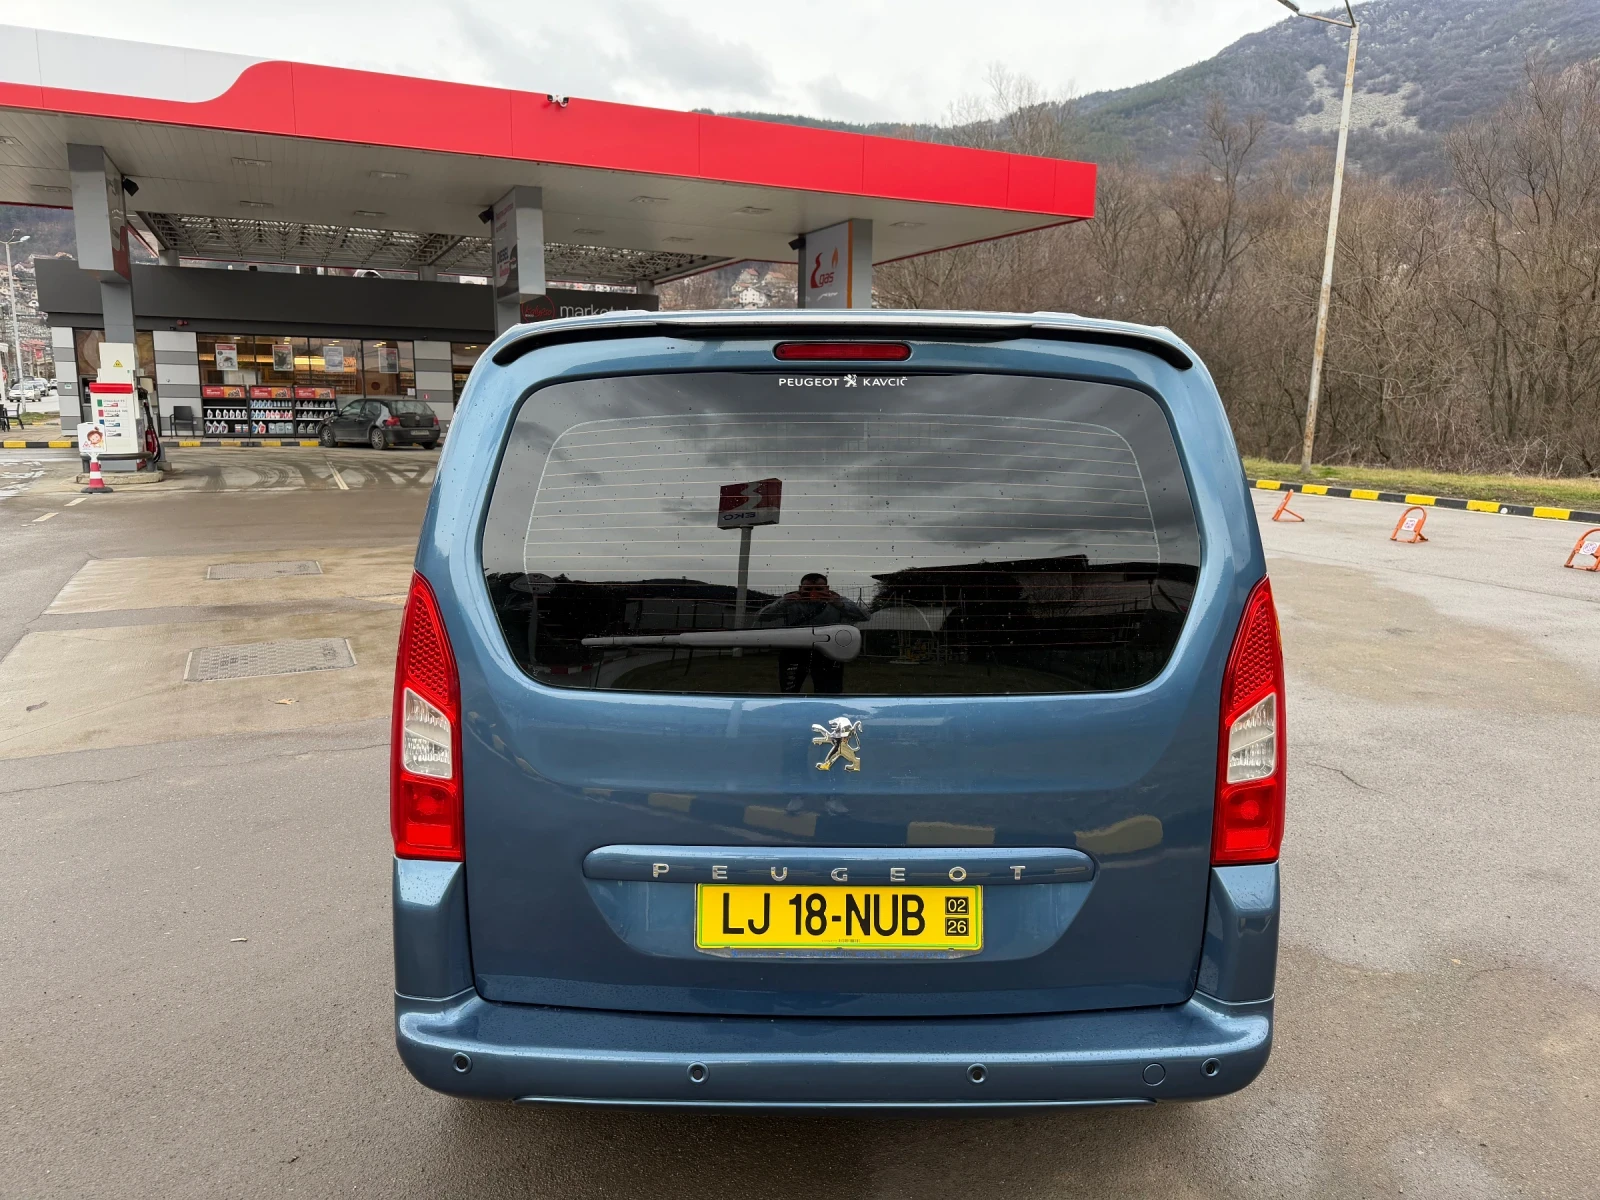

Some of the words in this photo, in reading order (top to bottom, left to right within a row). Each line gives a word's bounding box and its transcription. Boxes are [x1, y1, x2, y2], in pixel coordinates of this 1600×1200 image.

[778, 377, 840, 387] PEUGEOT
[652, 863, 1026, 883] PEUGEOT
[947, 898, 967, 913] 02
[722, 892, 771, 935] LJ
[788, 893, 926, 937] 18-NUB
[947, 920, 967, 934] 26
